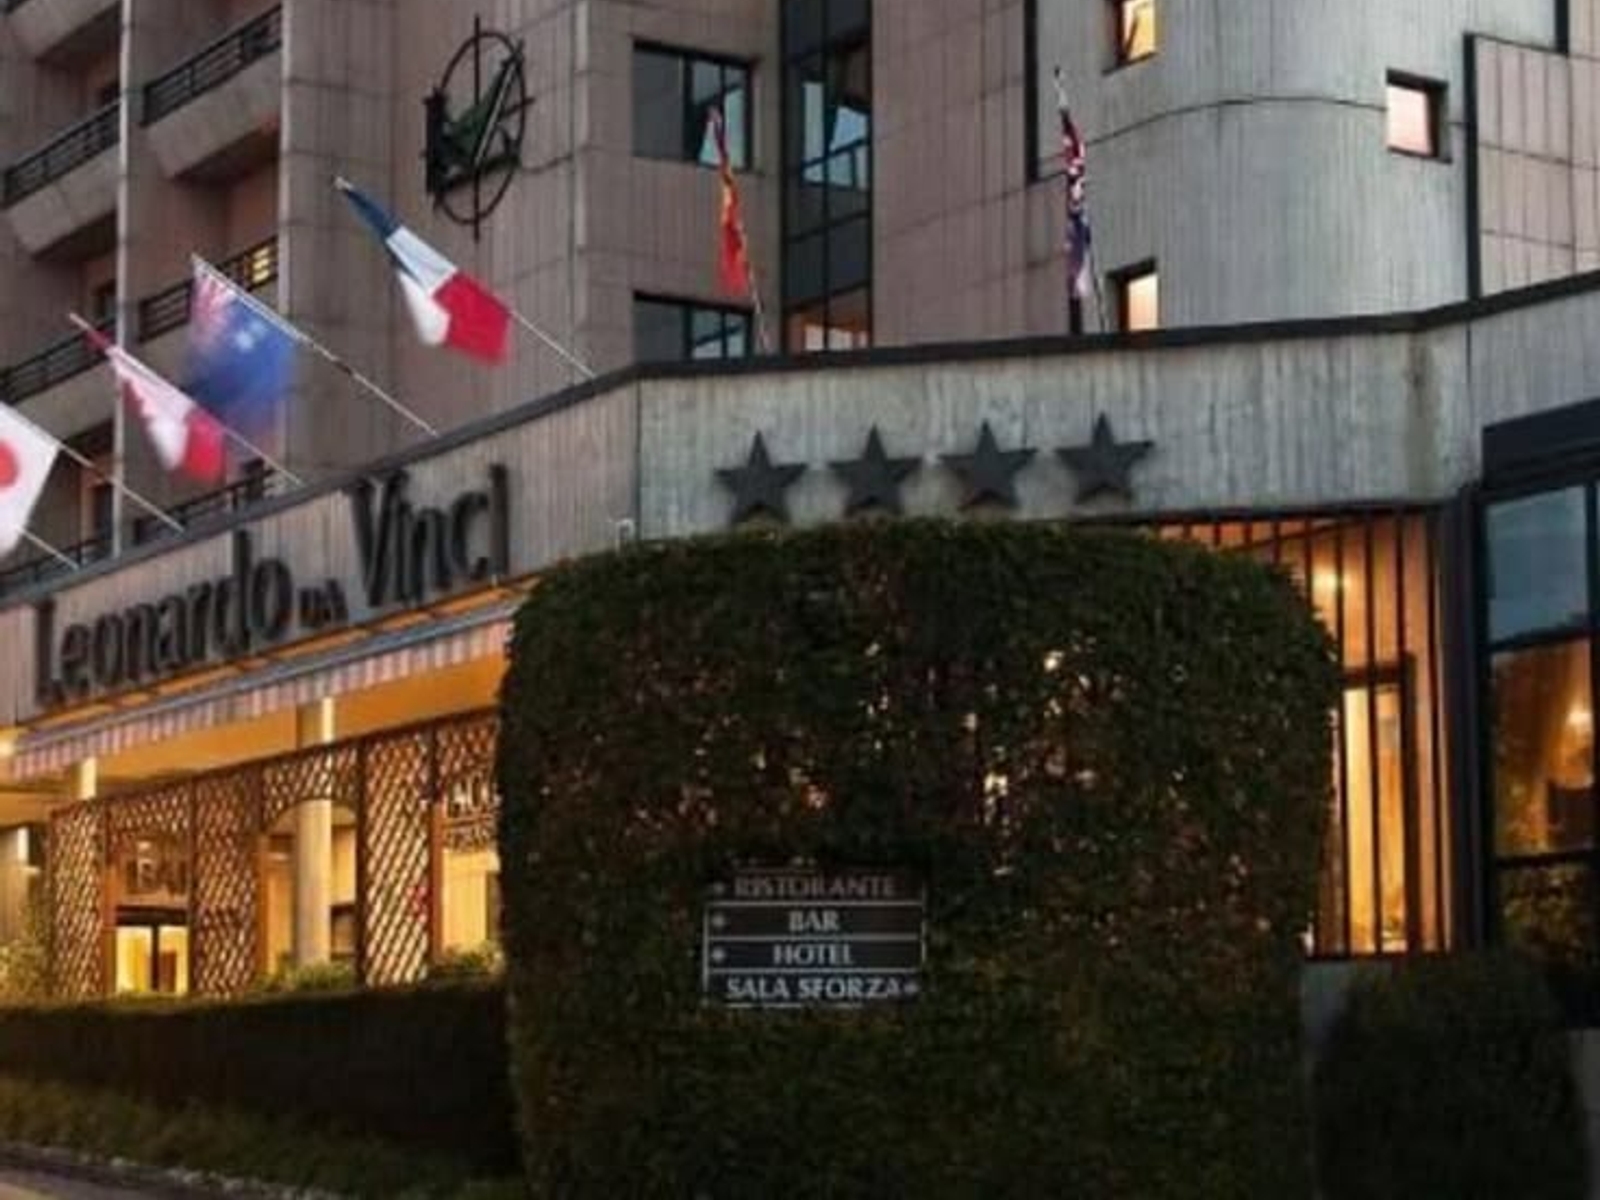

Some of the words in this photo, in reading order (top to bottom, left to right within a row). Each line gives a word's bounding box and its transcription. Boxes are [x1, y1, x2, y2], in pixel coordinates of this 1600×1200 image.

[33, 527, 293, 705] Leonardo
[350, 462, 509, 609] Vinci
[733, 877, 896, 898] RISTORANTE
[788, 910, 840, 932] BAR
[772, 944, 854, 965] HOTEL
[726, 977, 790, 999] SALA
[798, 977, 900, 999] SFORZA
